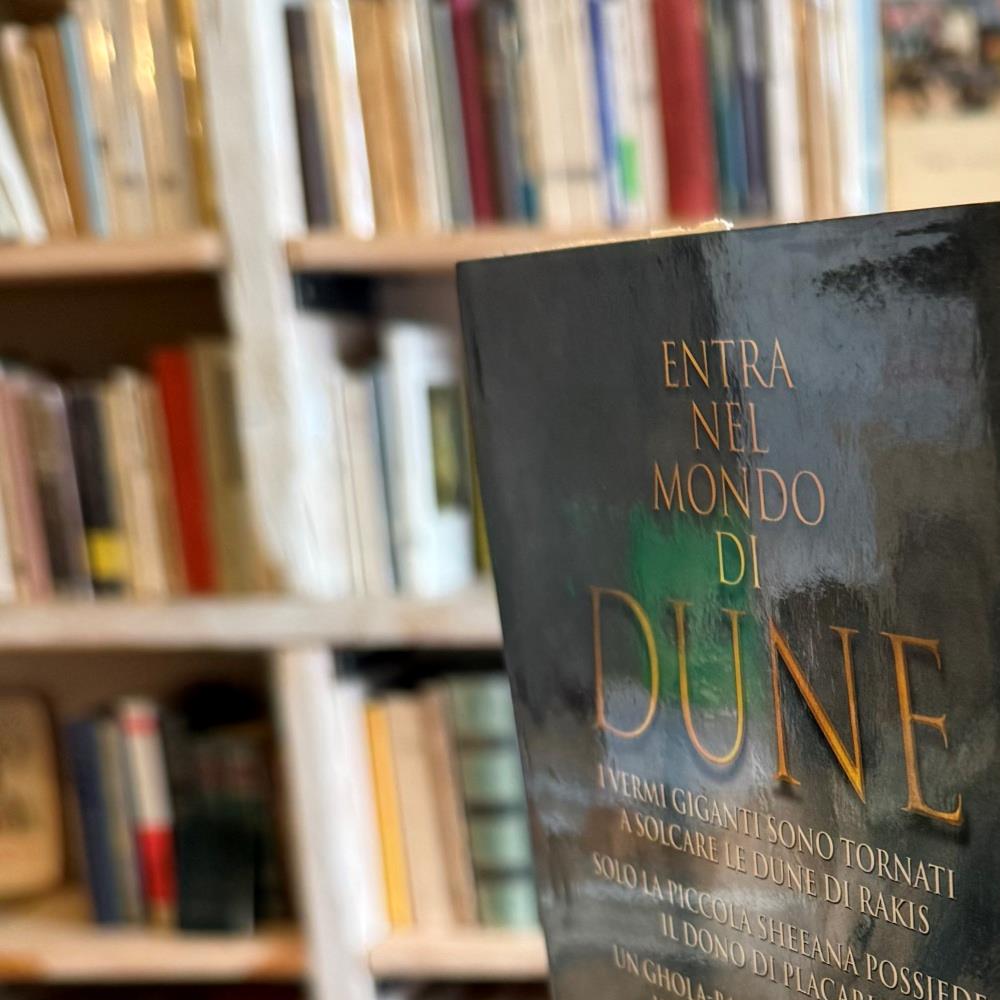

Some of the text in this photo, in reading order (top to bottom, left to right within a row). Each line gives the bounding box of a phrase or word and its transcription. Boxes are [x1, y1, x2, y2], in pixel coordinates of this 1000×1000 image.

[660, 336, 797, 390] ENTRA
[692, 400, 770, 454] NEL
[653, 461, 826, 527] MONDO
[716, 531, 761, 590] DI
[589, 585, 963, 828] DUNE
[599, 765, 956, 900] I VERMI GIGANTI SONO TORNATI
[619, 809, 931, 935] A SOLCARE LE DUNE DI RAKIS
[592, 851, 638, 889] SOLO
[642, 869, 665, 901] LA
[668, 879, 754, 936] PICCOLA
[757, 914, 859, 976] SHEEANA
[660, 912, 679, 942] IL
[683, 920, 746, 968] DONO
[752, 950, 777, 982] DI
[612, 944, 640, 977] UN
